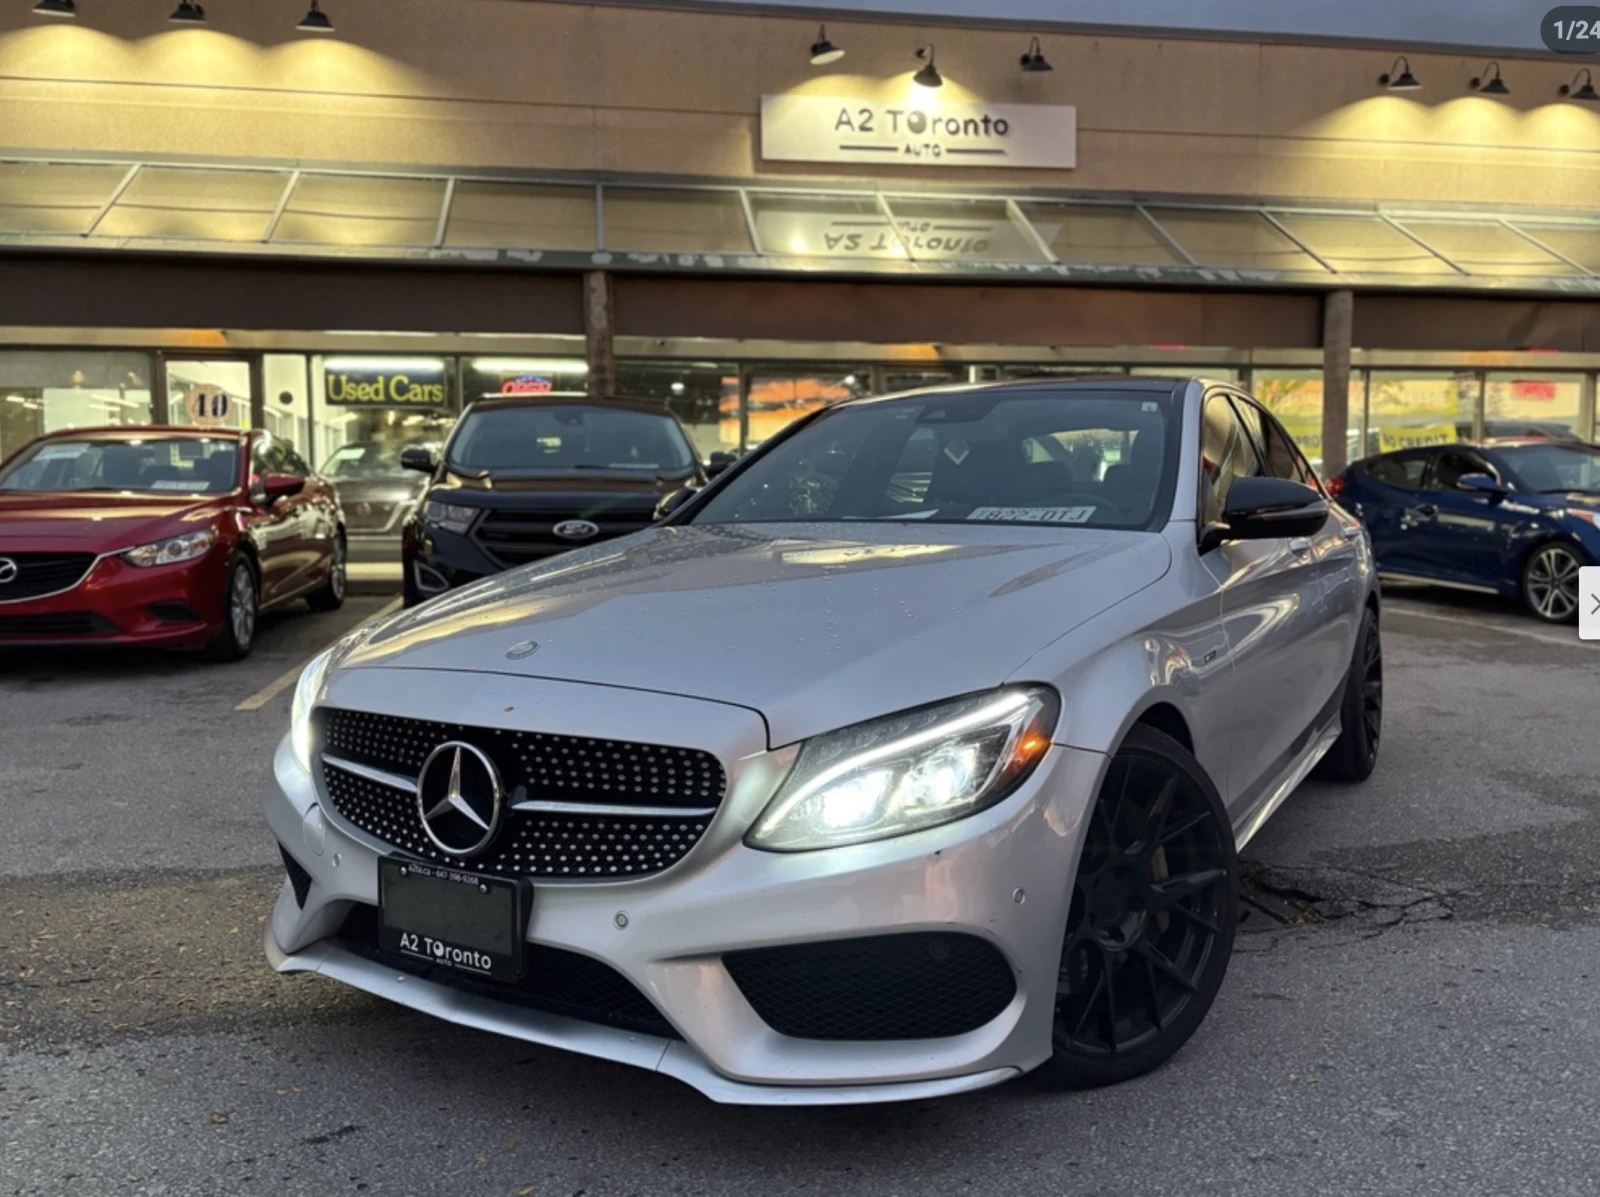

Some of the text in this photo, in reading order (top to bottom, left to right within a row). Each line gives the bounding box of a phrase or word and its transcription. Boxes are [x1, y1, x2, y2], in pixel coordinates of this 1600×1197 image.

[834, 107, 874, 132] A2
[903, 143, 942, 158] AUTO
[327, 374, 443, 402] Used Cars
[399, 931, 420, 952] A2
